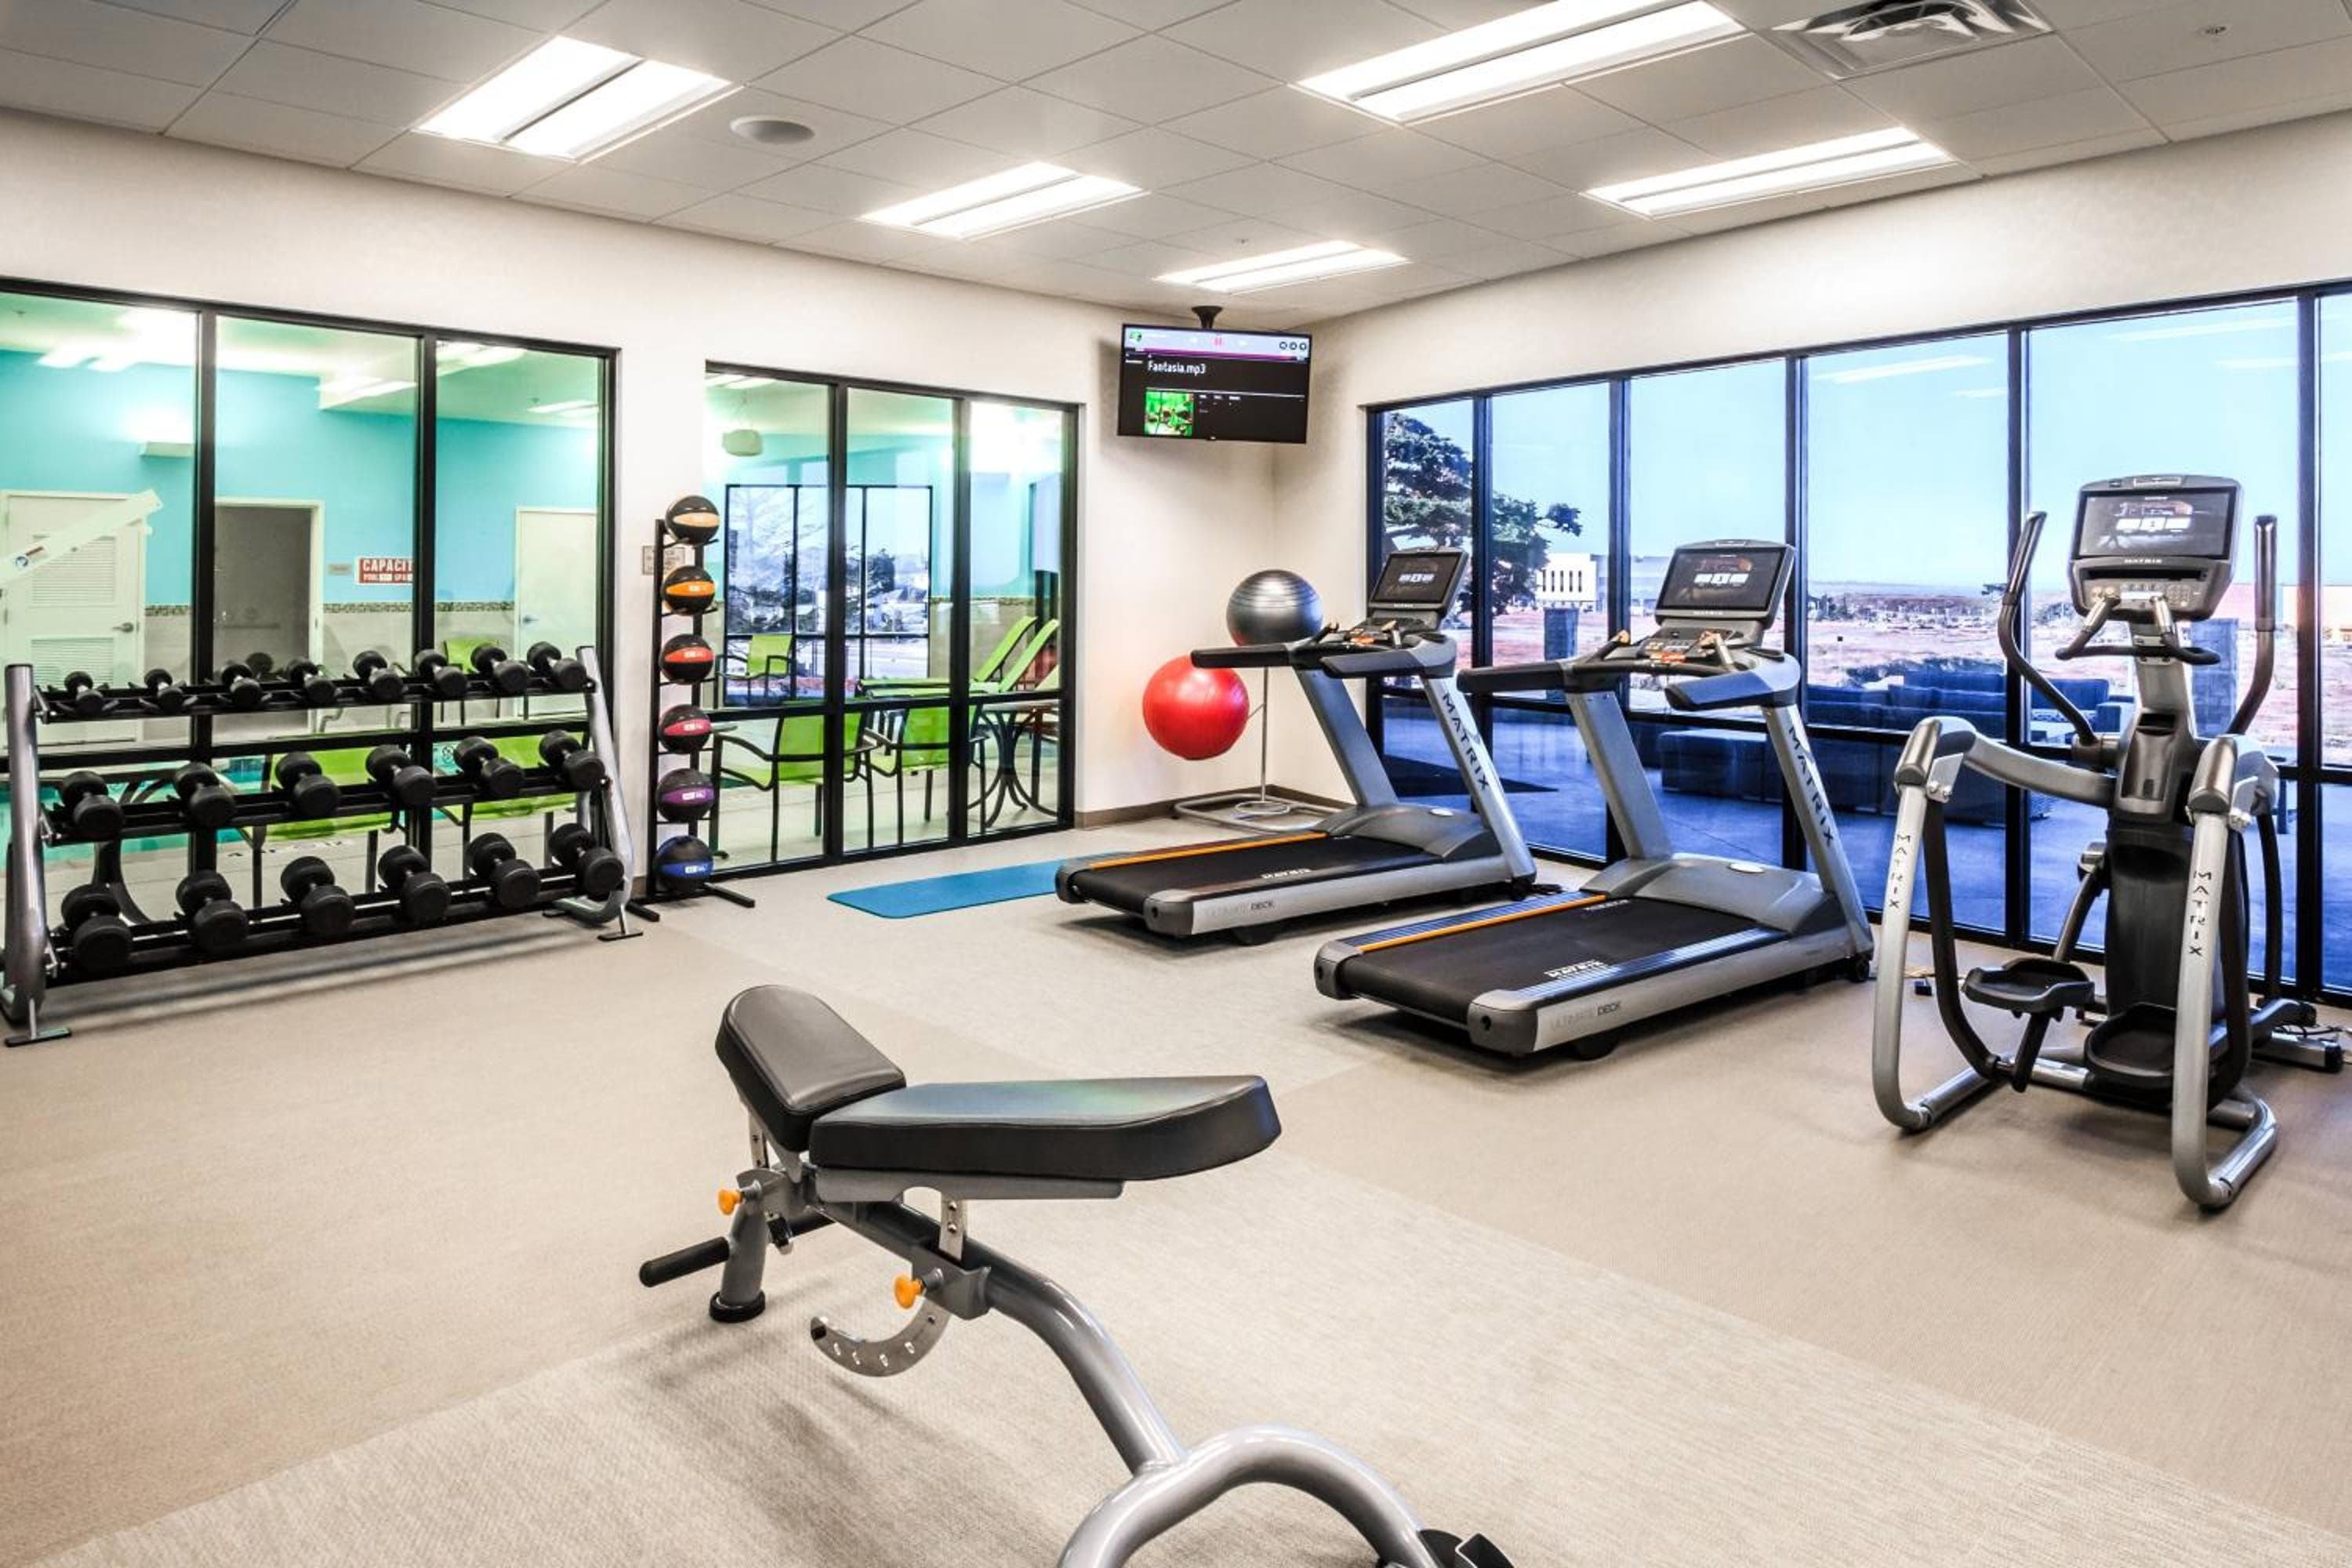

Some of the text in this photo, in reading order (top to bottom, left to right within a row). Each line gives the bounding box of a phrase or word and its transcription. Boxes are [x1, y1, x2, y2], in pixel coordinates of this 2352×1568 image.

[1147, 361, 1206, 376] Fantasia.mp3
[363, 559, 413, 572] CAPACIT
[1443, 692, 1489, 790] MATRIX
[1788, 727, 1833, 847] MATRIX
[1889, 834, 1911, 909] MATRIX
[2189, 870, 2212, 956] MATRIX
[1597, 1000, 1621, 1016] DECK
